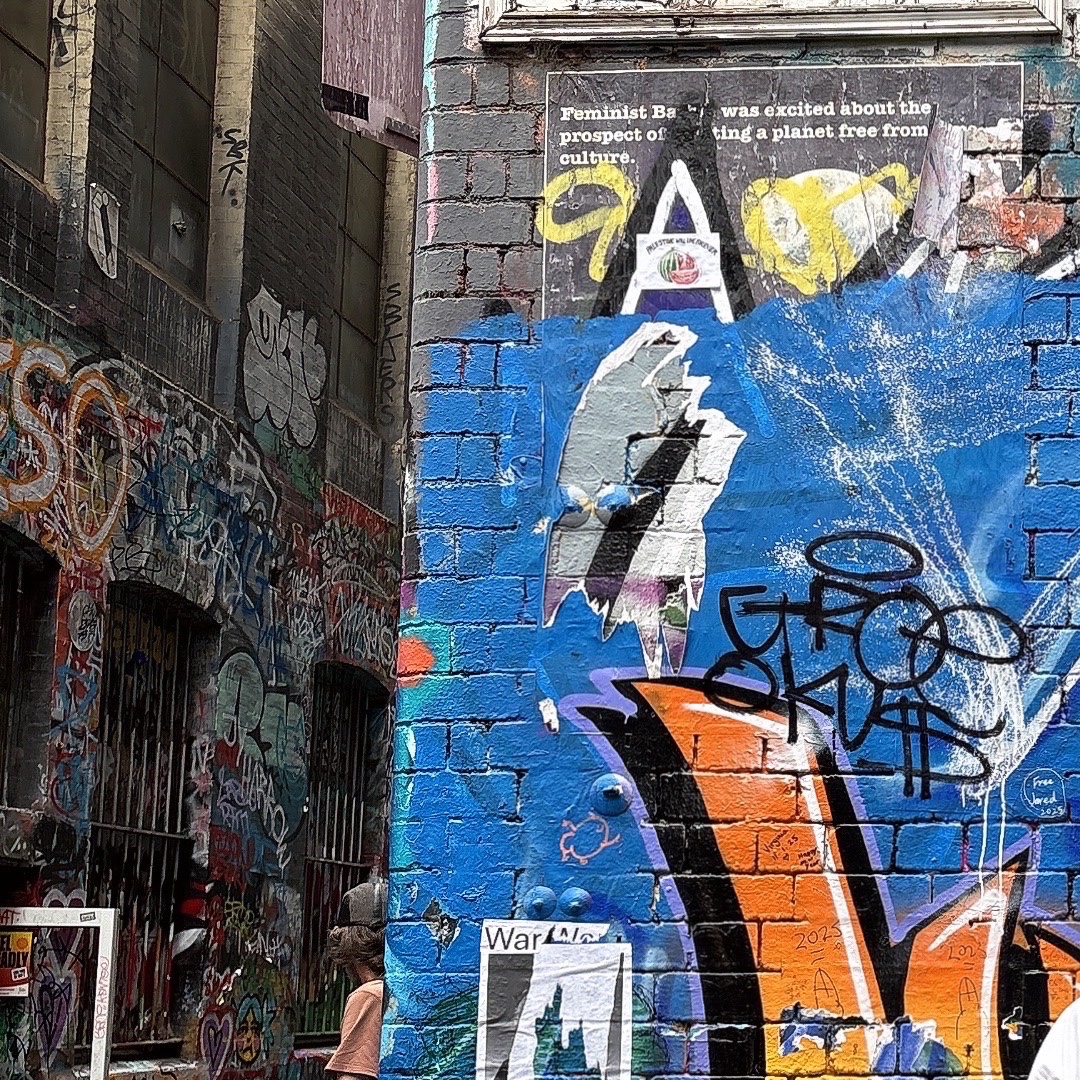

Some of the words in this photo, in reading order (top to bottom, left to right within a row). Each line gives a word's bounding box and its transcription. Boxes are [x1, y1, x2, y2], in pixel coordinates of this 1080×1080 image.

[560, 106, 647, 121] Feminist
[720, 105, 760, 118] was
[763, 102, 835, 117] excited
[840, 101, 895, 117] about
[898, 101, 931, 116] the
[559, 127, 642, 148] prospect
[646, 126, 666, 142] of
[756, 129, 768, 141] a
[771, 122, 834, 144] planet
[837, 123, 878, 138] free
[882, 122, 929, 138] from
[559, 150, 636, 166] culture.
[646, 237, 675, 256] PALESTINE
[1033, 776, 1054, 789] Free
[1040, 805, 1064, 816] 2025
[485, 926, 543, 950] War
[794, 924, 843, 950] 2025
